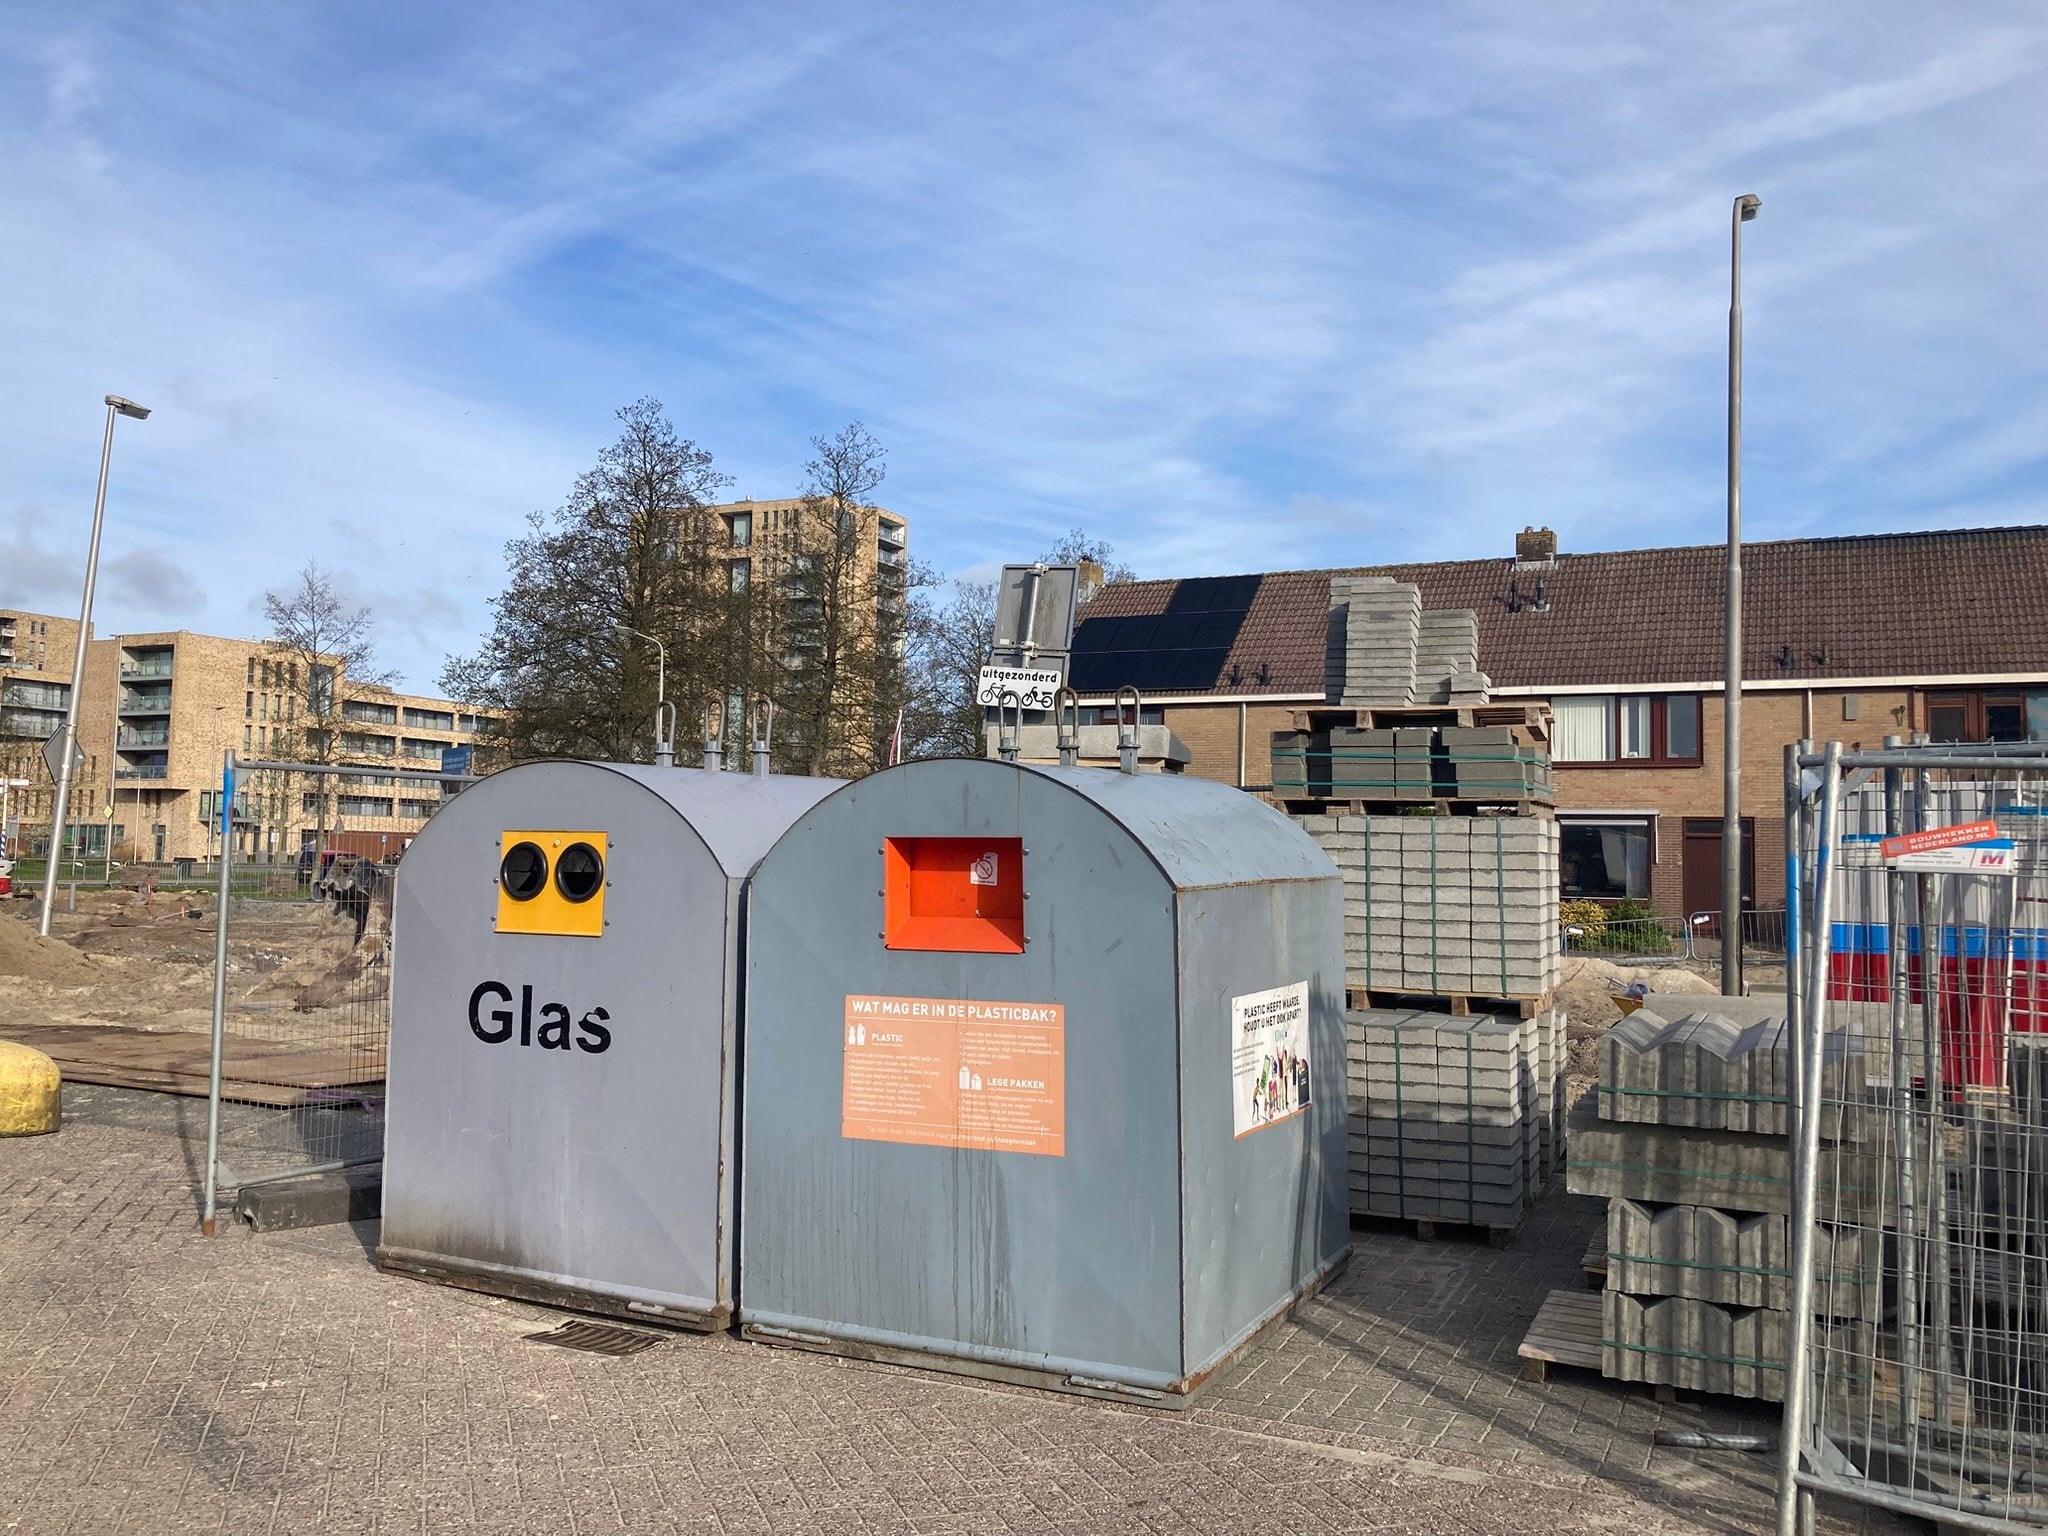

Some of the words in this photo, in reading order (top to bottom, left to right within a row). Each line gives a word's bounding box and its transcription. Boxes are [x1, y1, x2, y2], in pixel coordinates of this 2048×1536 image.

[982, 669, 1058, 683] uitgezonderd
[1909, 825, 1990, 844] BOUWHEKKEN
[1910, 832, 1990, 851] NEDERLAND.NL
[468, 980, 612, 1054] Glas
[852, 1001, 880, 1014] WAT
[883, 1002, 909, 1016] MAG
[912, 1003, 929, 1016] ER
[932, 1003, 945, 1017] IN
[949, 1004, 964, 1018] DE
[968, 1006, 1057, 1022] PLASTICBAK?
[1244, 1004, 1266, 1019] PLASTIC
[1267, 1000, 1282, 1013] HEEFT
[1244, 1019, 1260, 1033] HOUDT
[1265, 1015, 1276, 1027] HET
[1277, 1013, 1286, 1024] OOK
[872, 1033, 903, 1042] PLASTIC
[987, 1078, 1008, 1088] LEGE
[1010, 1079, 1044, 1089] PAKKEN
